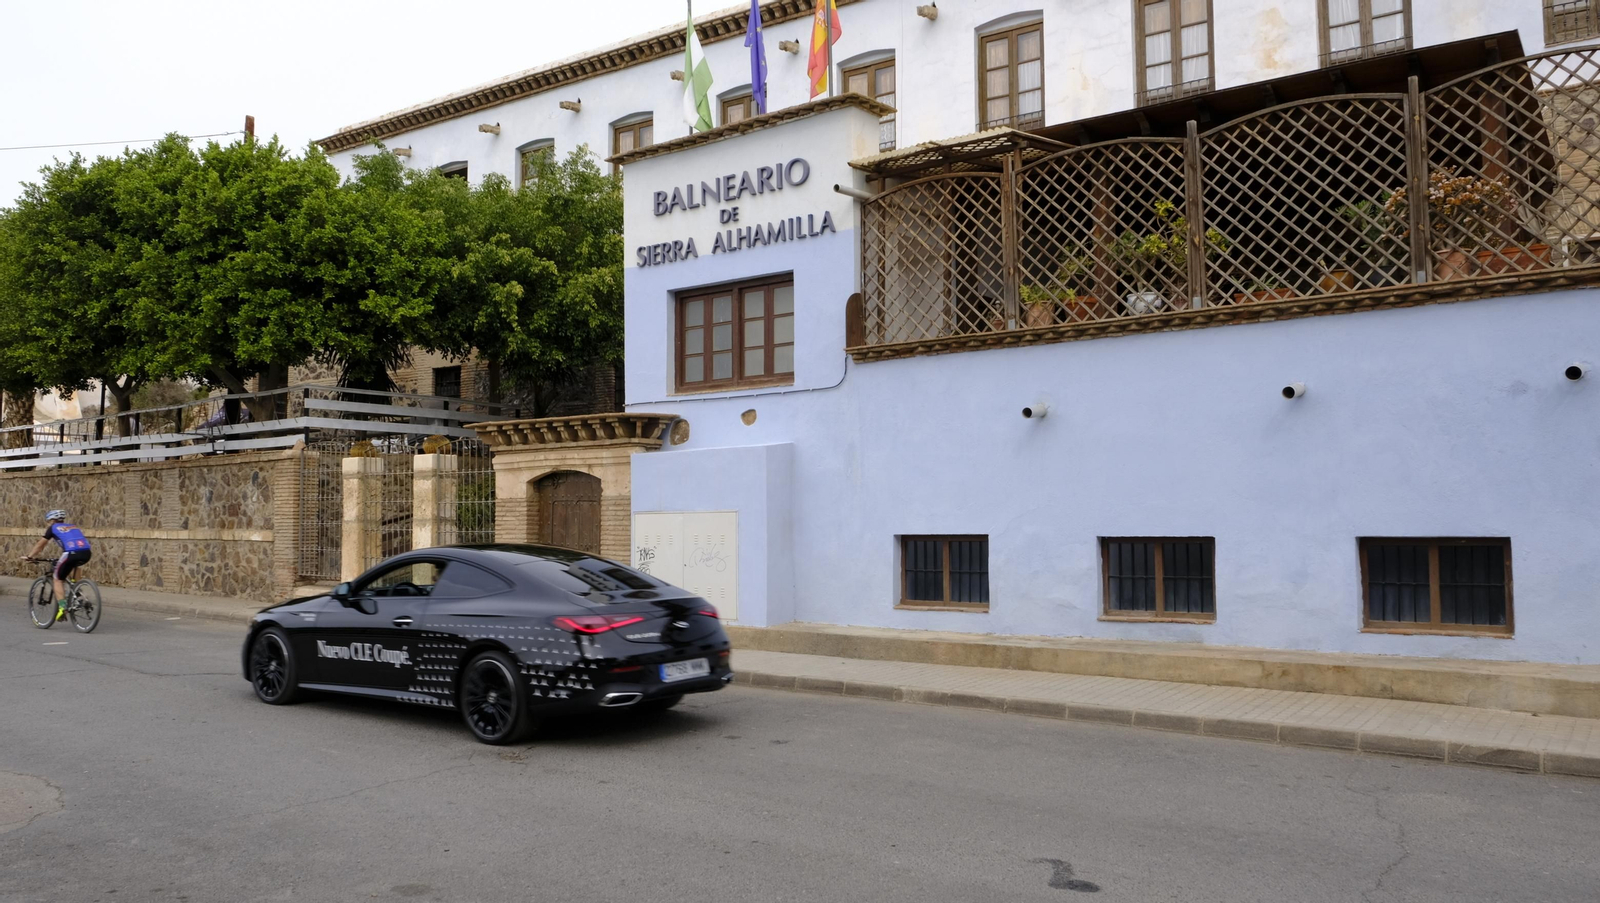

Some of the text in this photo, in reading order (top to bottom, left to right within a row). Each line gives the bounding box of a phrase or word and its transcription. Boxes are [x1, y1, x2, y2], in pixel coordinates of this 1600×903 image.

[653, 157, 811, 217] BALNEARIO
[719, 206, 739, 224] DE
[636, 210, 836, 268] SIERRA ALHAMILLA
[316, 640, 350, 660] Nuevo
[350, 642, 374, 662] CLE
